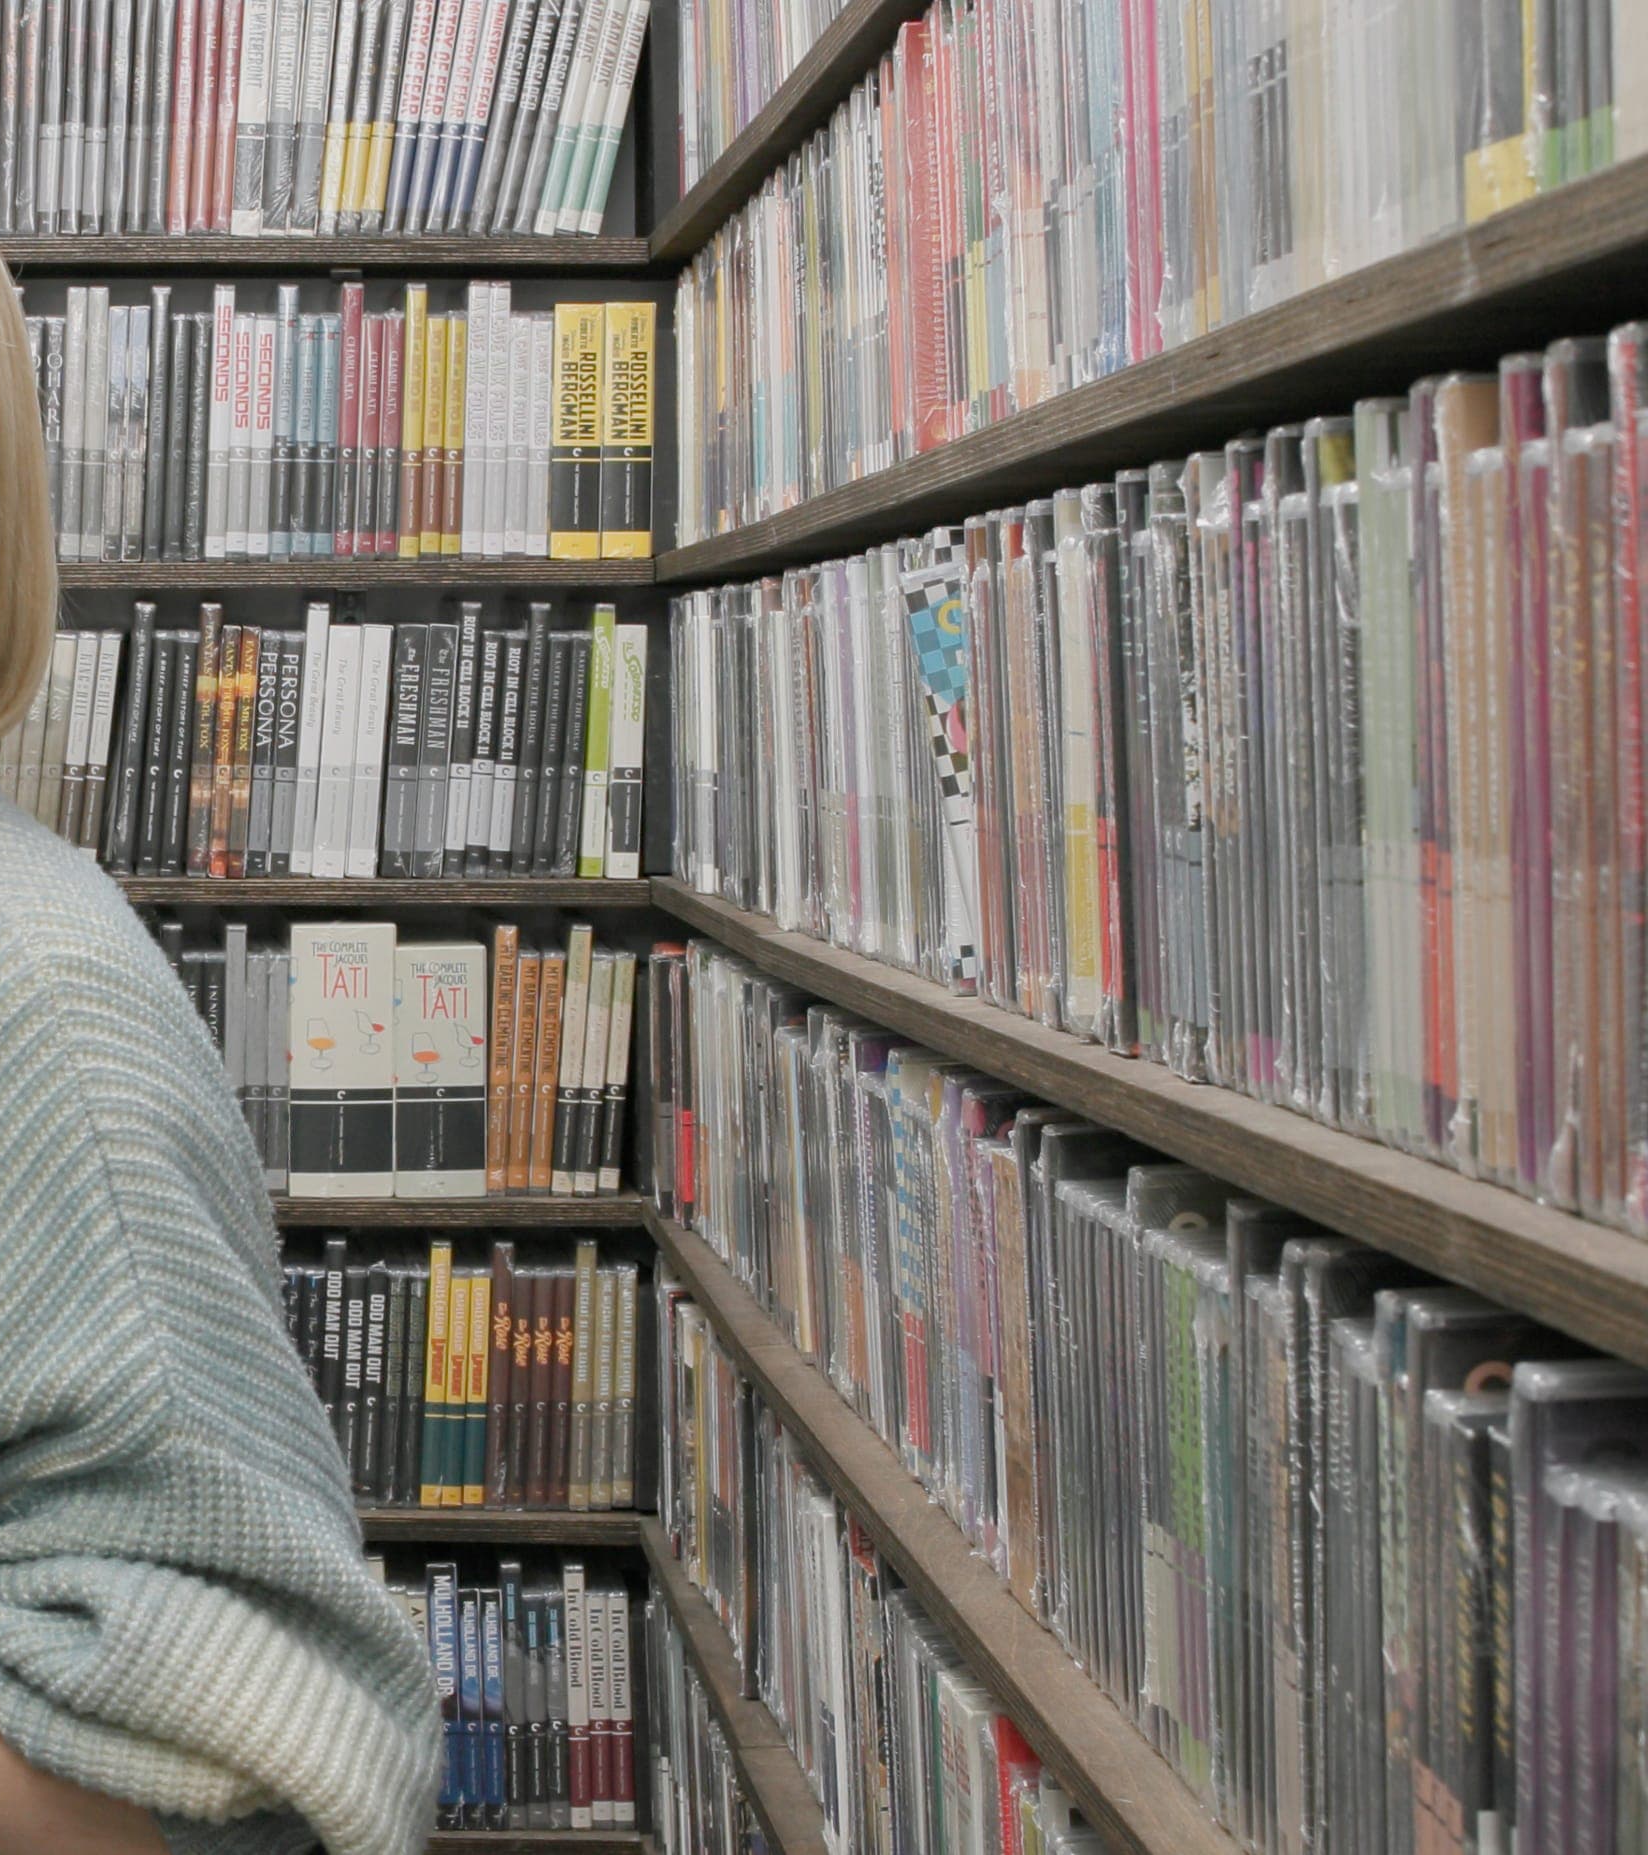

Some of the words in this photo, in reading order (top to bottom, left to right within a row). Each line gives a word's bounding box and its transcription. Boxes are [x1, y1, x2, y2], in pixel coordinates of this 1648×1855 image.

[283, 8, 296, 32] THE
[458, 2, 481, 65] MINISTRY
[512, 10, 529, 39] MAN
[615, 15, 645, 89] BADLANDS
[275, 36, 294, 110] WATERFRONT
[454, 68, 469, 85] OF
[499, 43, 522, 102] ESCAPED
[447, 87, 467, 119] FEAR
[235, 332, 249, 428] SECONDS
[257, 333, 272, 430] SECONDS
[323, 367, 332, 384] THE
[345, 336, 355, 400] CHARULATA
[491, 358, 505, 387] AUX
[323, 385, 332, 404] BIG
[611, 361, 629, 440] BERGMAN
[630, 352, 648, 440] ROSSELLINI
[322, 405, 332, 432] CITY
[490, 391, 504, 440] FOLLES
[485, 642, 497, 668] RIOT
[533, 624, 543, 666] MASTER
[371, 659, 381, 674] The
[508, 648, 520, 674] RIOT
[532, 669, 541, 681] OF
[370, 678, 379, 701] Great
[484, 671, 495, 683] IN
[507, 677, 519, 689] IN
[179, 691, 187, 726] HISTORY
[256, 652, 277, 746] PERSONA
[278, 654, 298, 748] PERSONA
[427, 668, 449, 748] FRESHMAN
[482, 686, 494, 708] CELL
[505, 692, 517, 714] CELL
[530, 685, 540, 706] THE
[178, 728, 185, 738] OF
[366, 704, 377, 735] Beauty
[479, 712, 492, 744] BLOCK
[503, 717, 516, 749] BLOCK
[527, 711, 537, 744] HOUSE
[239, 728, 249, 751] FOX
[501, 752, 512, 760] 11
[312, 942, 327, 960] THE
[329, 941, 368, 953] COMPLETE
[335, 953, 368, 965] JACQUES
[317, 954, 368, 999] TATI
[411, 963, 427, 982] THE
[429, 963, 468, 975] COMPLETE
[434, 974, 468, 987] JACQUES
[546, 967, 560, 978] MY
[416, 975, 468, 1019] TATI
[543, 983, 559, 1021] DARLING
[541, 1024, 556, 1074] CLEMENTINE
[349, 1300, 363, 1326] ODD
[370, 1295, 384, 1321] ODD
[474, 1288, 484, 1318] CHARLES
[346, 1330, 362, 1359] MAN
[368, 1324, 382, 1353] MAN
[474, 1320, 484, 1352] CHAPLIN
[494, 1315, 510, 1350] Rose
[345, 1363, 360, 1388] OUT
[366, 1358, 380, 1383] OUT
[433, 1576, 452, 1669] MULHOLLAND
[487, 1601, 498, 1661] MULHOLLAND
[590, 1609, 603, 1624] In
[611, 1609, 625, 1625] In
[590, 1627, 603, 1663] Cold
[610, 1629, 626, 1664] Cold
[487, 1665, 498, 1680] DR.
[592, 1666, 605, 1708] Blood
[612, 1667, 626, 1709] Blood
